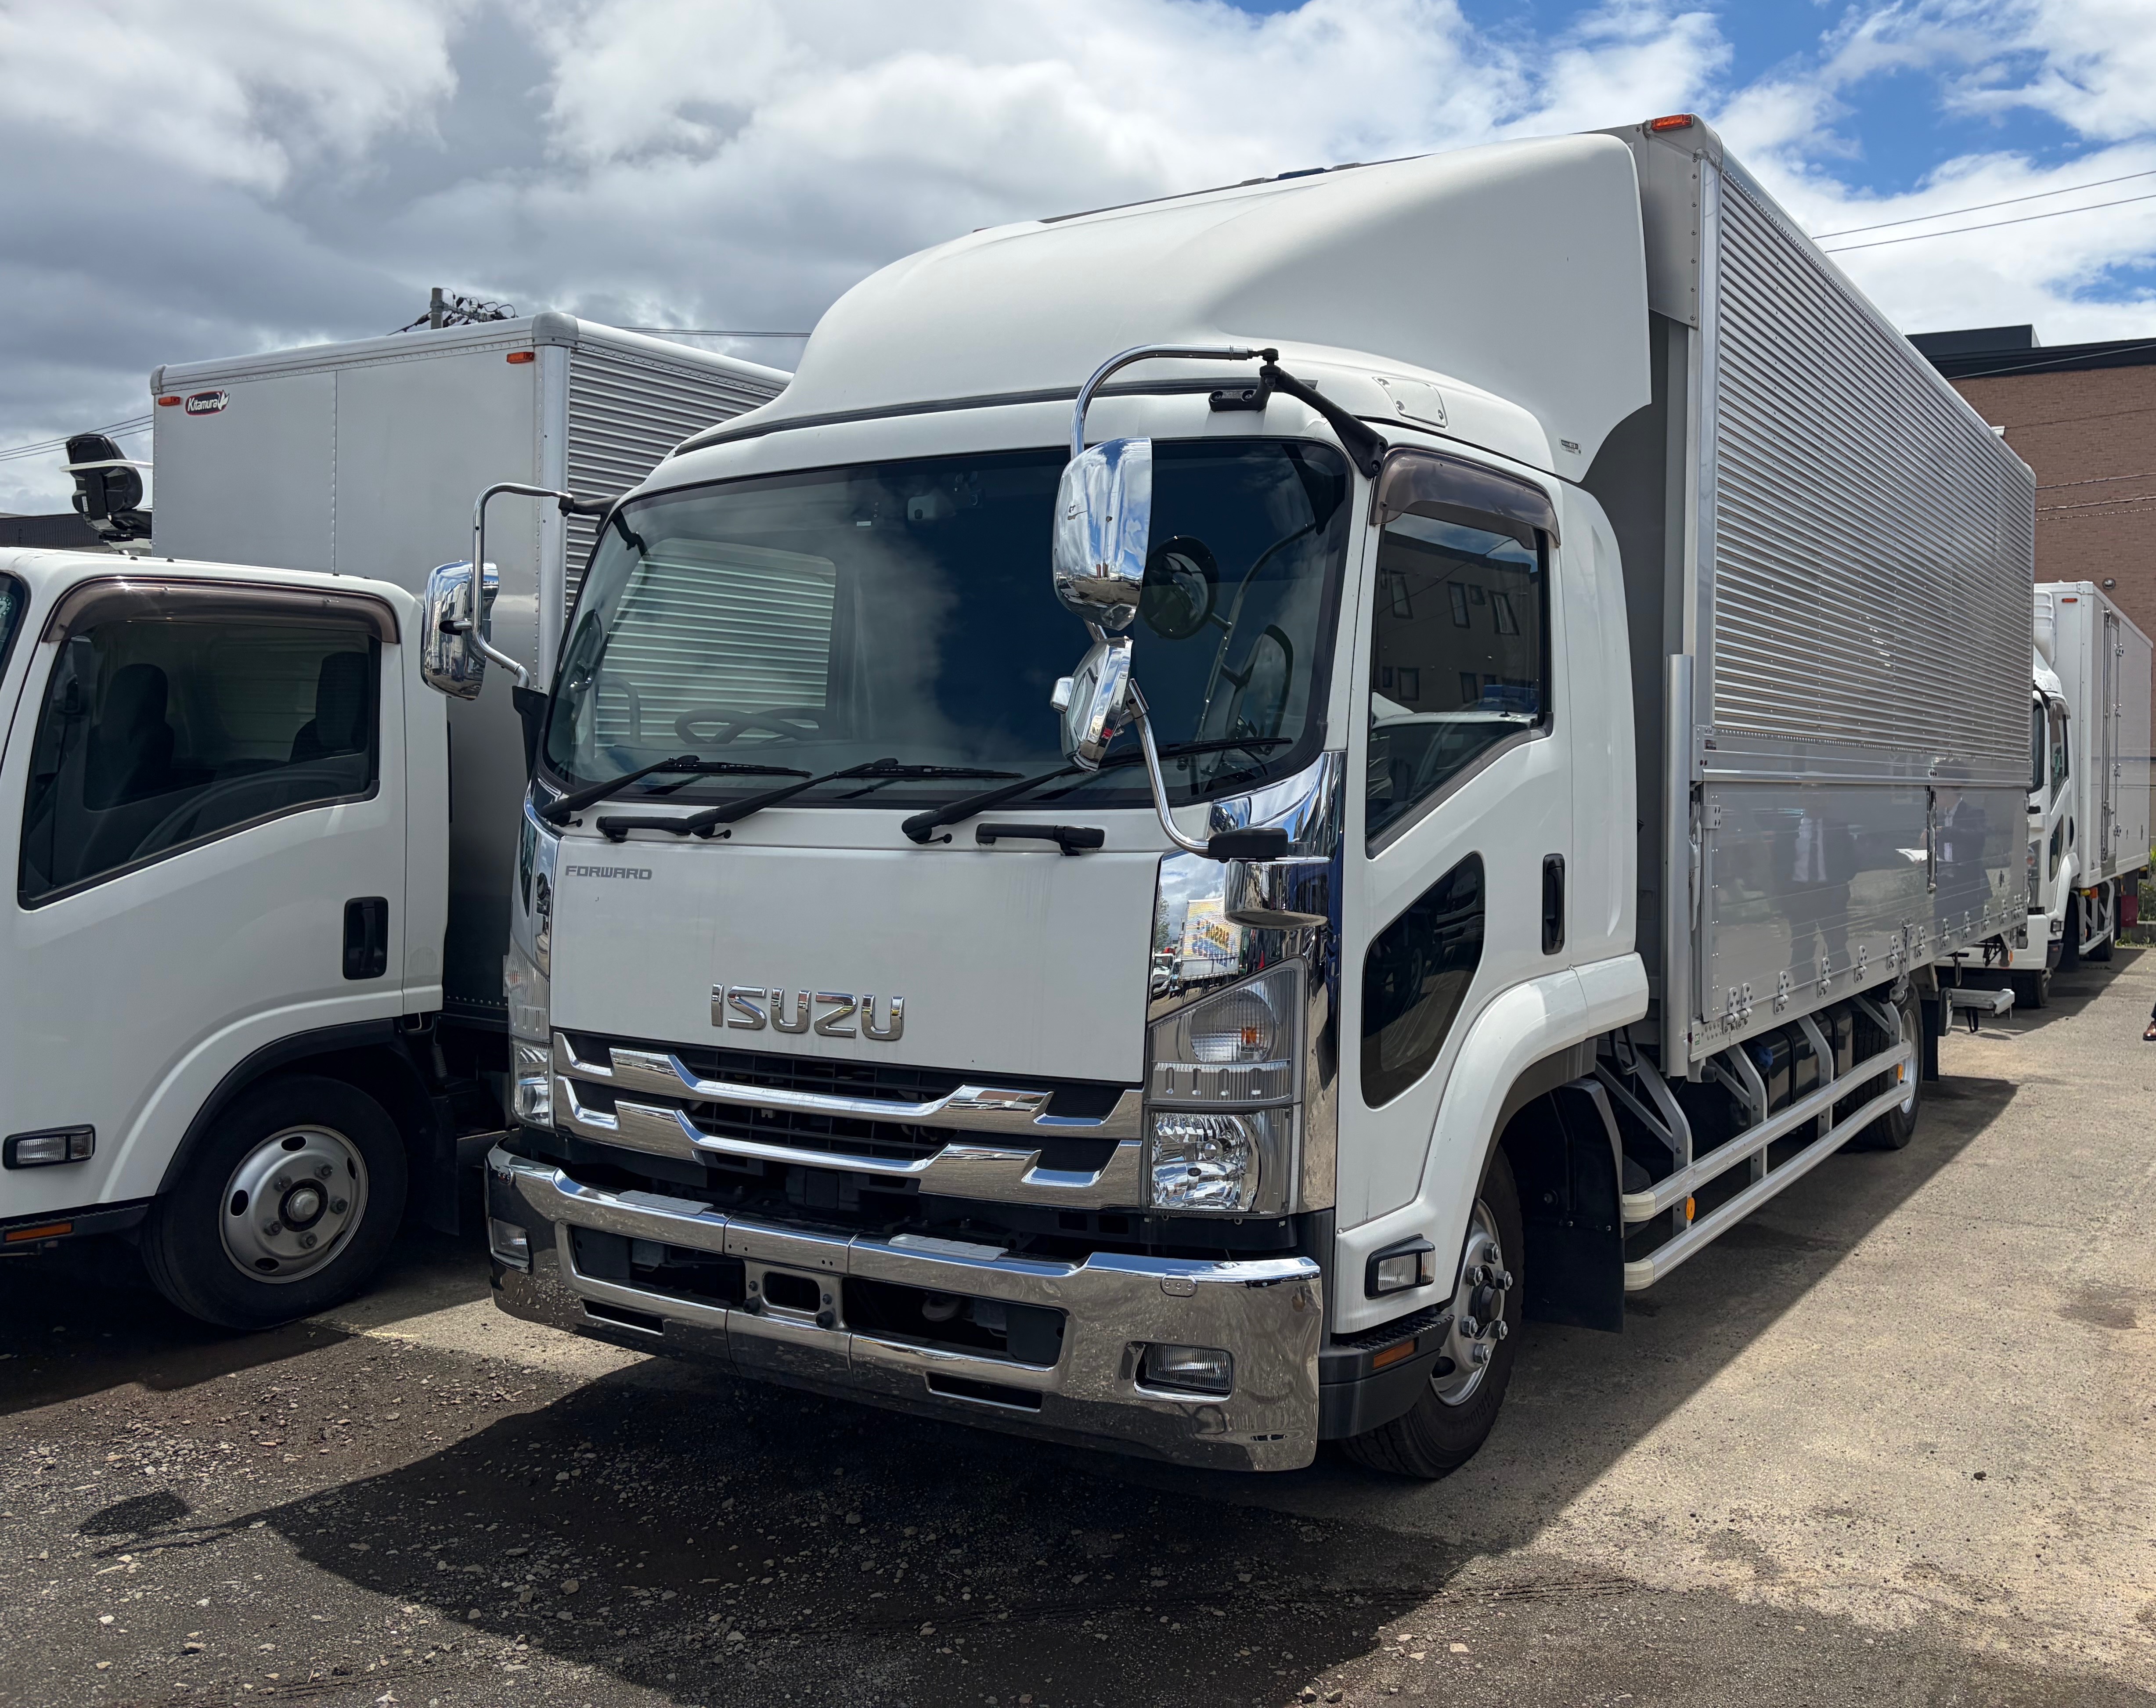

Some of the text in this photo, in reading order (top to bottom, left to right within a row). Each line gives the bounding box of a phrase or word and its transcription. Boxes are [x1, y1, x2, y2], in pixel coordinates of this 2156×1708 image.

[187, 396, 218, 411] Kitamura
[565, 865, 653, 880] FORWARD
[711, 983, 905, 1040] ISUZU
